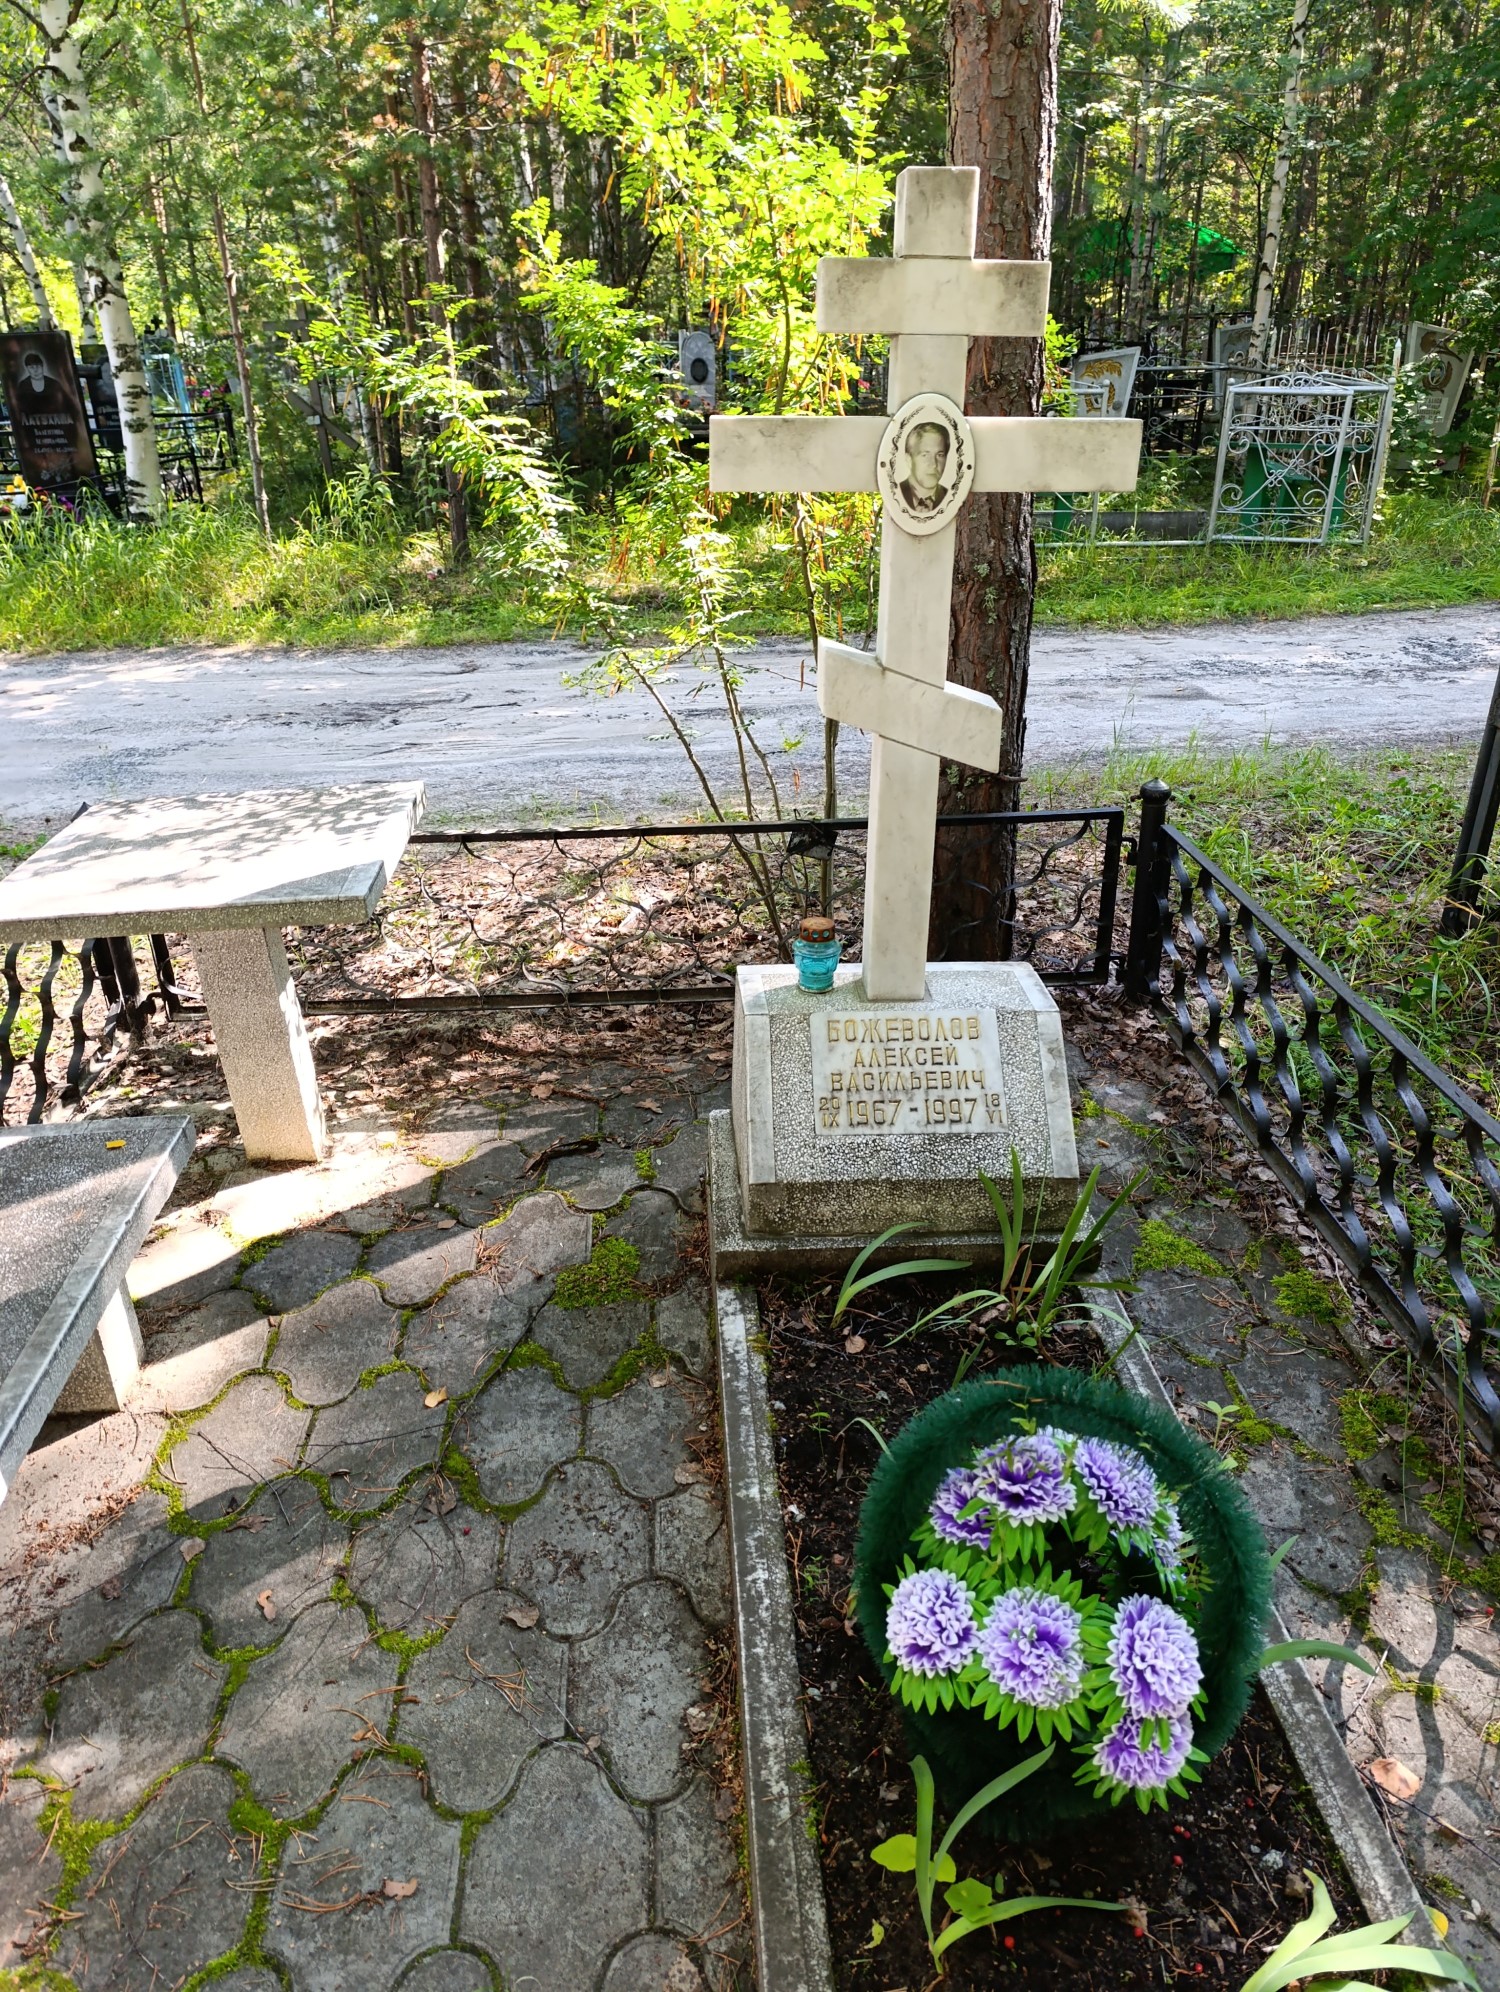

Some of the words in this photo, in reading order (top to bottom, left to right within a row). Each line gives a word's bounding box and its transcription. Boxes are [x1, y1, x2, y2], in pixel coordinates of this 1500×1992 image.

[827, 1017, 981, 1043] БОЖЕВОЛОВ
[854, 1043, 959, 1068] АЛЕКСЕЙ
[830, 1070, 986, 1093] ВАСИЛЬЕВИЧ
[819, 1096, 840, 1111] 20
[984, 1093, 1001, 1108] 18
[822, 1112, 840, 1128] IX
[985, 1109, 1004, 1124] VI
